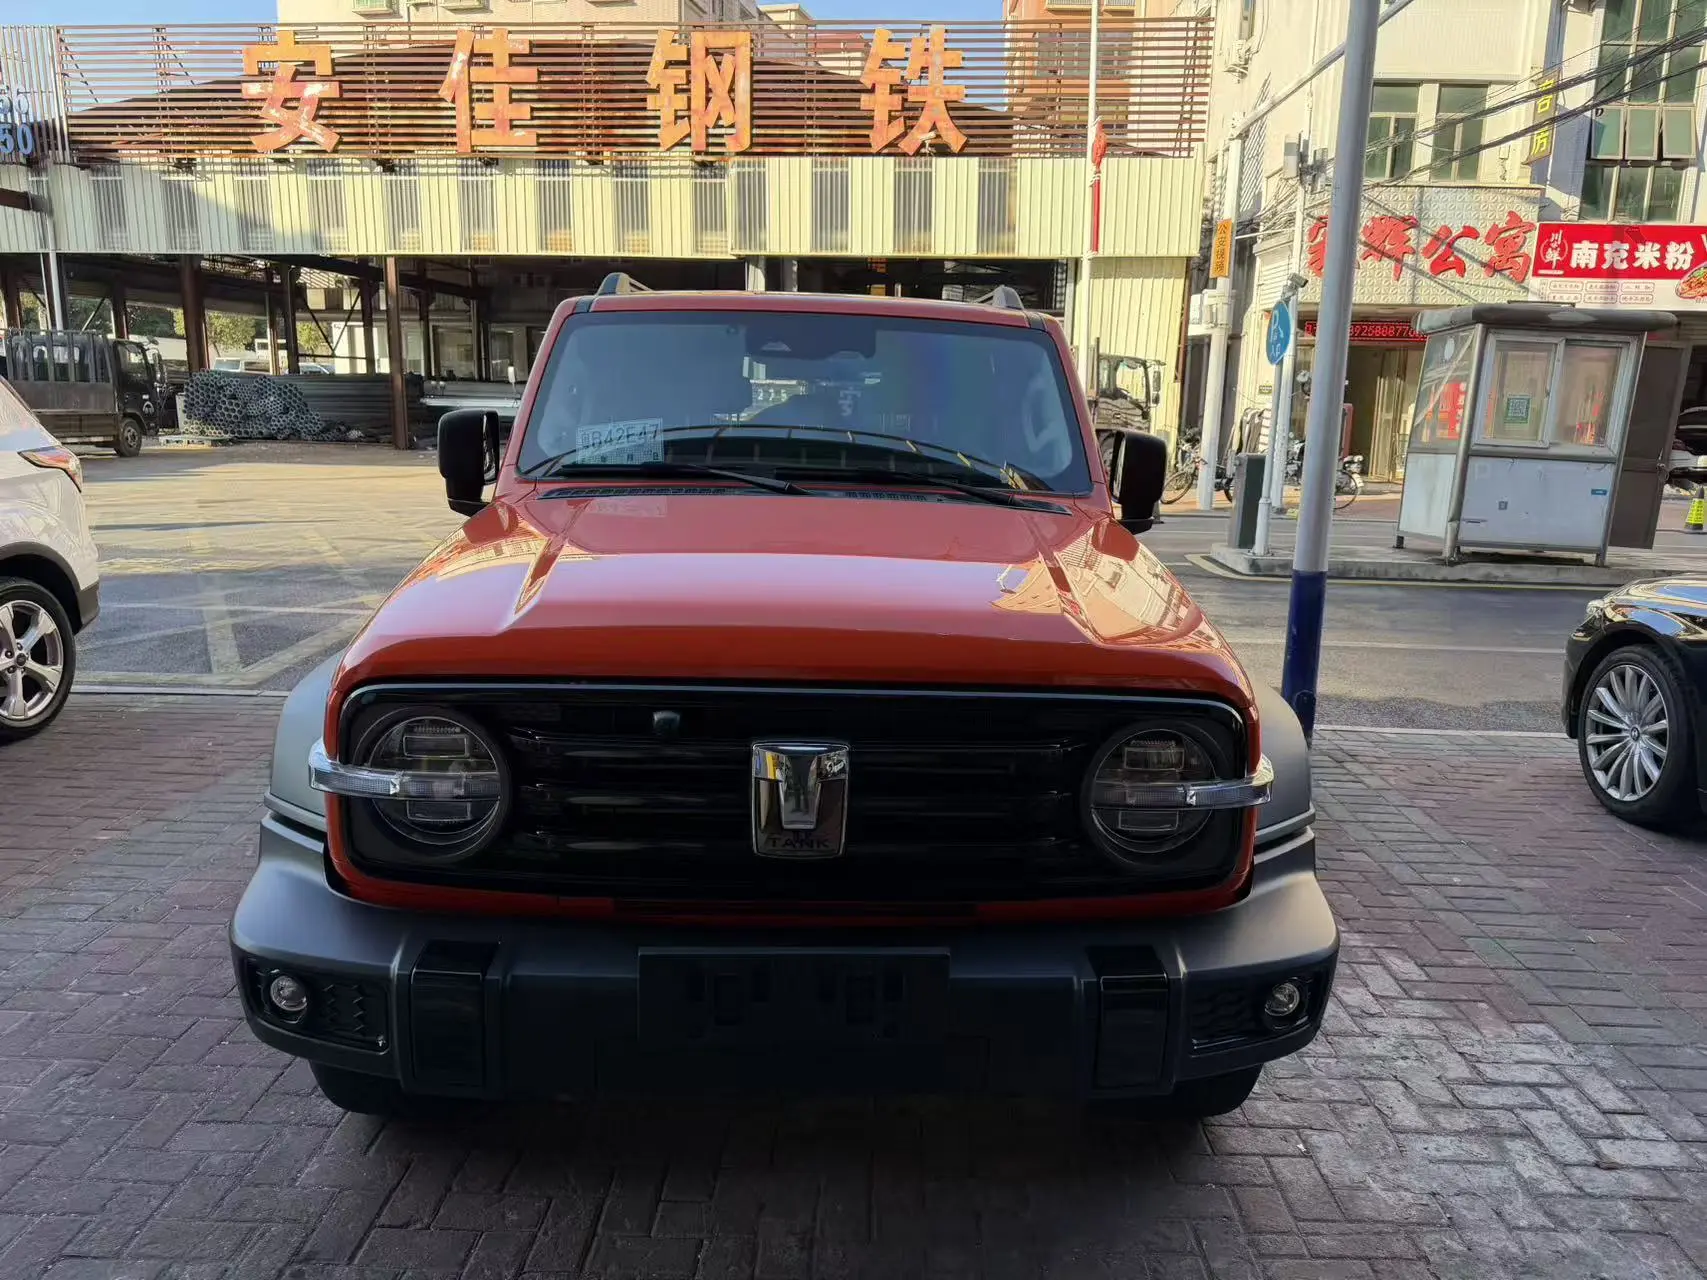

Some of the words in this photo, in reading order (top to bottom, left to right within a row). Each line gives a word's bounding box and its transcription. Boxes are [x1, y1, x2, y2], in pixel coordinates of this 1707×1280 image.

[241, 27, 967, 153] 安佳钢铁
[1570, 240, 1695, 270] 南充米粉
[769, 837, 830, 849] TANK
